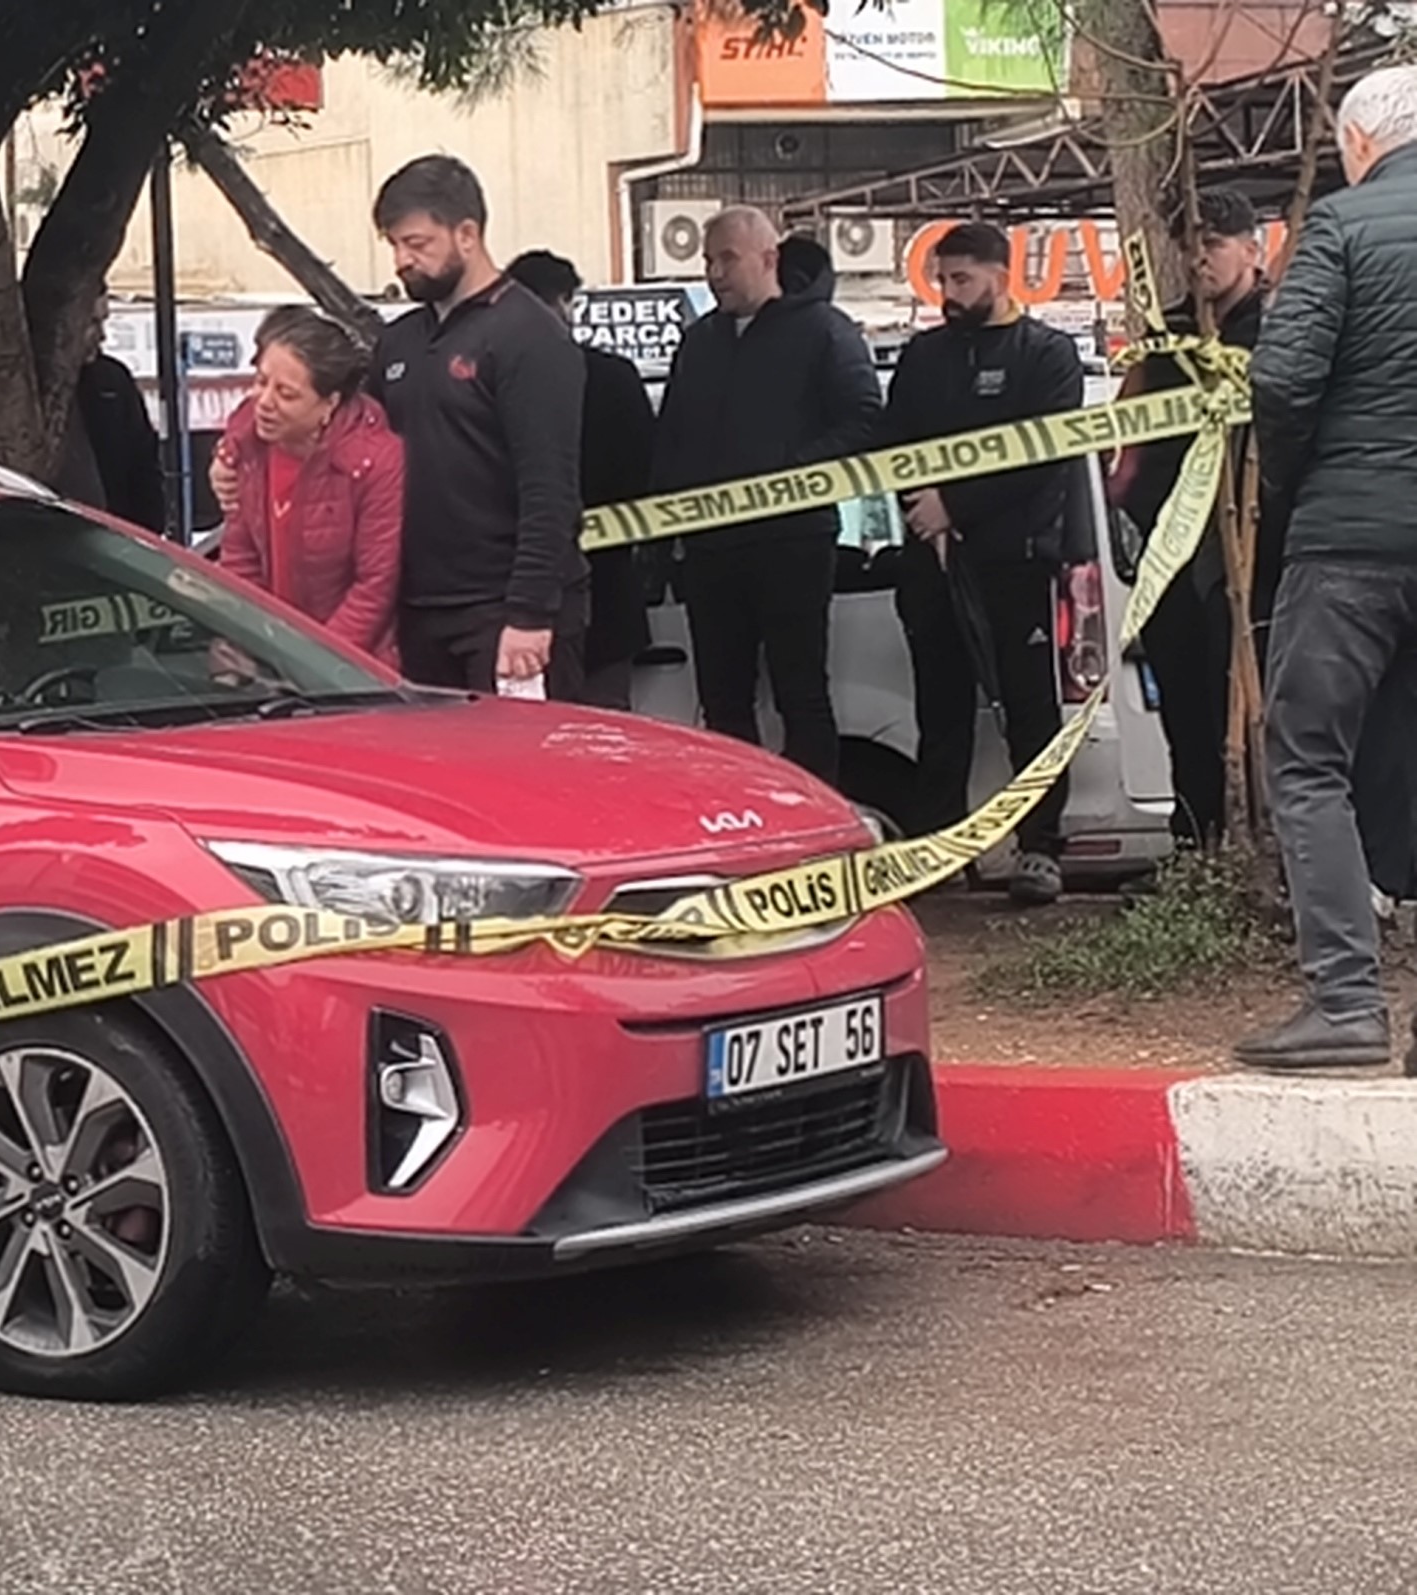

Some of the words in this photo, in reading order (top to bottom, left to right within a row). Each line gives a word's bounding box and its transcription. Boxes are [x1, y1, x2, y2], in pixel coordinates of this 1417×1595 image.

[572, 294, 681, 324] YEDEK
[572, 324, 682, 347] PARCA
[727, 1030, 762, 1086] 07
[775, 1016, 824, 1077] SET
[845, 1005, 874, 1060] 56
